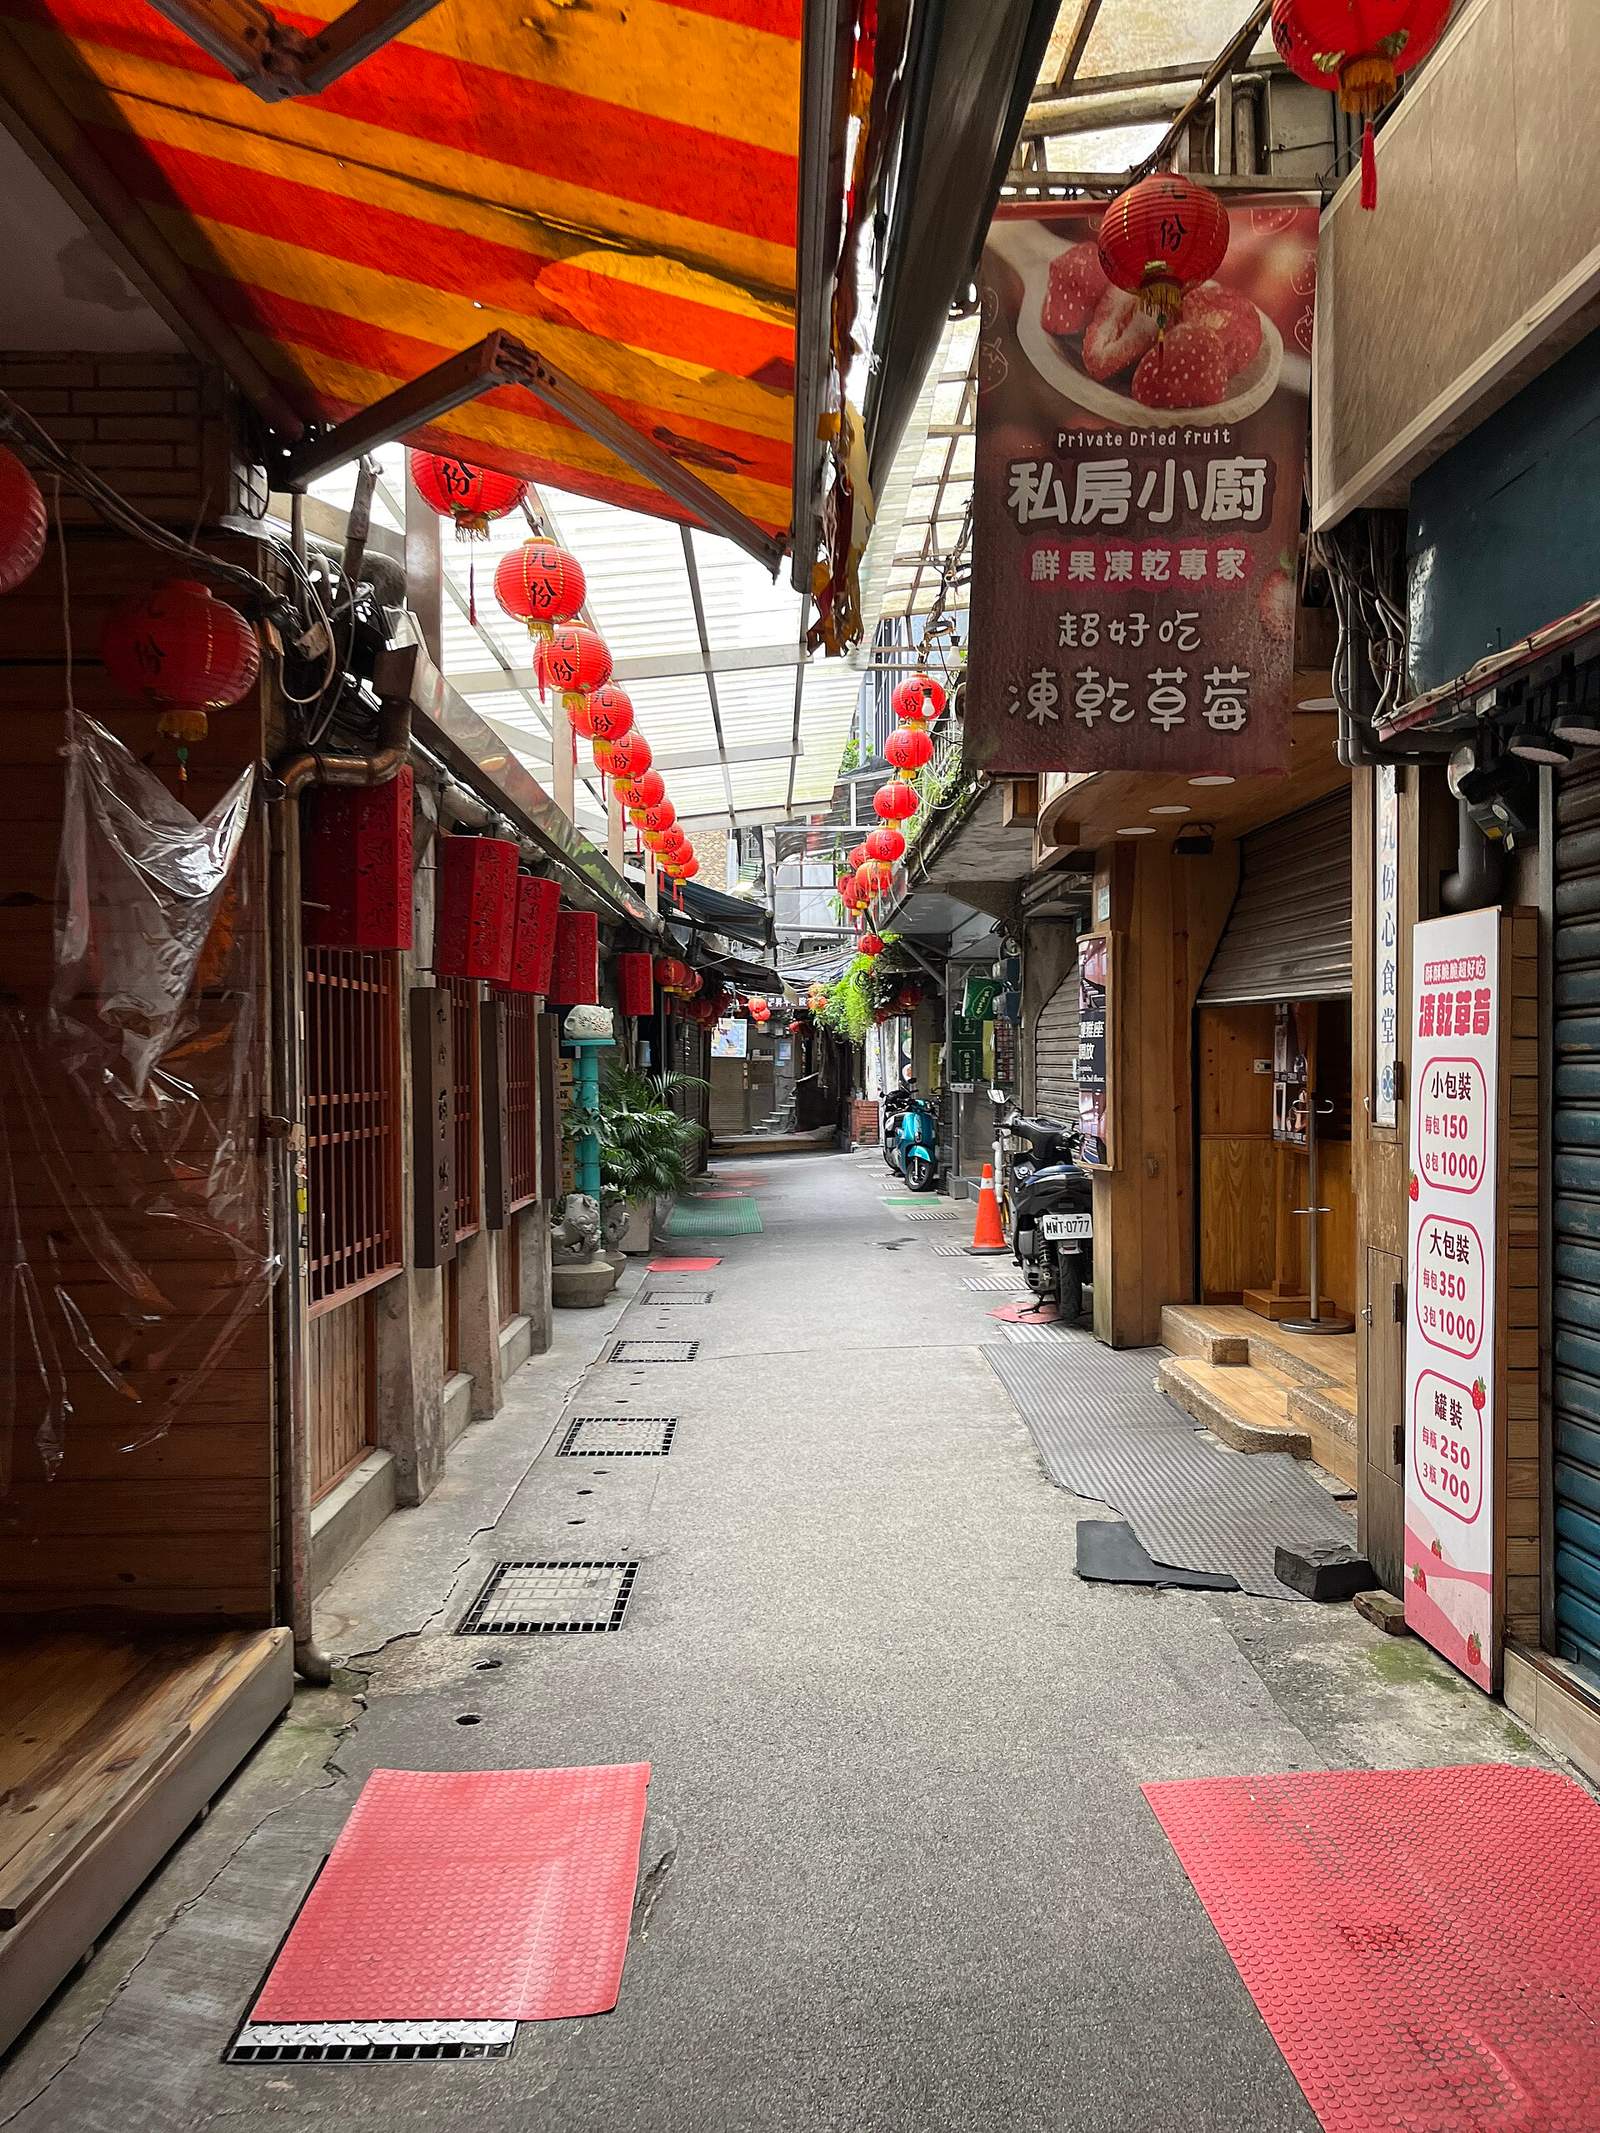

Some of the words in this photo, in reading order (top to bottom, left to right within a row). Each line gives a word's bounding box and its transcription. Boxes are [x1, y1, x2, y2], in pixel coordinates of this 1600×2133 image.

[1058, 431, 1123, 448] Private
[1130, 430, 1176, 446] Dried
[1184, 428, 1231, 445] fruit
[1007, 456, 1268, 527] 私房小廚
[529, 551, 557, 608] 九份
[1030, 547, 1247, 583] 鮮果凍乾專家
[1059, 609, 1200, 651] 超好吃
[553, 634, 576, 682] 九份
[592, 691, 613, 732] 九份
[1008, 665, 1250, 732] 凍乾草莓
[1380, 815, 1396, 1044] 九份心食堂
[1419, 988, 1491, 1037] 凍乾草莓
[1431, 1071, 1472, 1101] 小包裝
[1425, 1114, 1440, 1135] 每包
[1442, 1114, 1469, 1140] 150
[1441, 1151, 1478, 1180] 1000
[1429, 1228, 1470, 1264] 大包裝
[1423, 1267, 1437, 1291] 每包
[1439, 1270, 1466, 1302] 350
[1438, 1308, 1476, 1344] 1000
[1434, 1390, 1463, 1431] 罐裝
[1440, 1434, 1471, 1471] 250
[1440, 1466, 1471, 1504] 700
